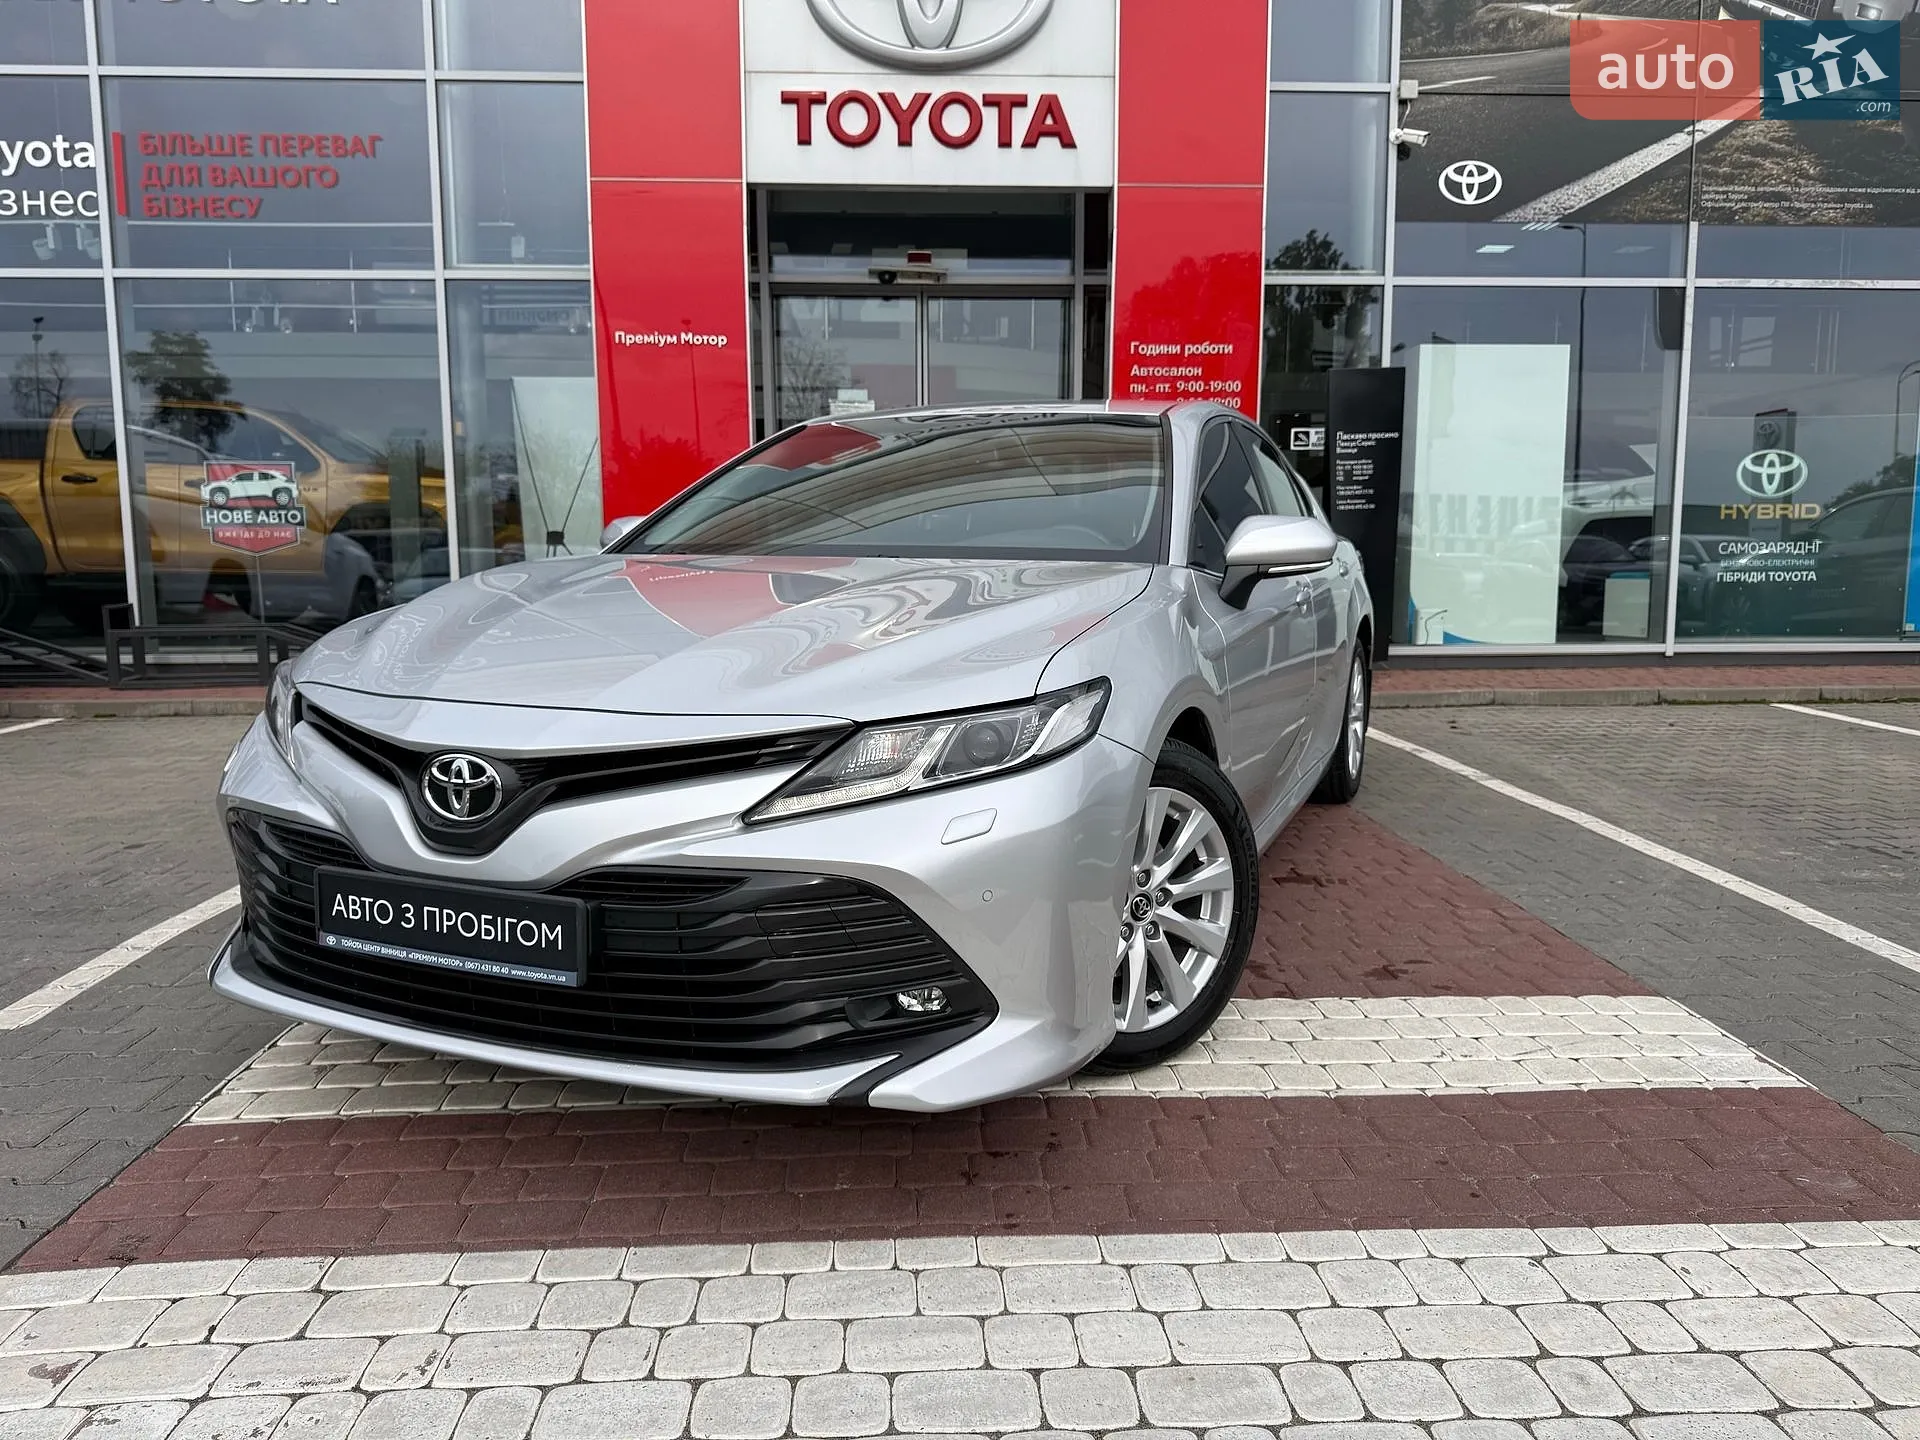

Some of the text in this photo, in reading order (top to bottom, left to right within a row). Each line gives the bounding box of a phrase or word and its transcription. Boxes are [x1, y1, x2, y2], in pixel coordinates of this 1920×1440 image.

[780, 91, 1077, 149] TOYOTA
[139, 131, 383, 157] БІЛЬШЕ ПЕРЕВАГ
[140, 164, 339, 189] ДЛЯ ВАШОГО
[143, 196, 262, 218] БІЗНЕСУ
[614, 331, 728, 348] Преміум Мотор
[1130, 341, 1233, 357] Години роботи
[1130, 364, 1202, 376] Автосалон
[1176, 381, 1241, 393] 9:00-19:00
[205, 509, 301, 524] НОВЕ АВТО
[1720, 503, 1821, 520] HYBRID
[1719, 540, 1821, 555] САМОЗАРЯДНІ
[1717, 571, 1817, 583] ГІБРИДИ TOYOTA
[331, 893, 563, 951] АВТО З ПРОБІГОМ
[341, 939, 362, 949] ТОЙОТА
[363, 943, 381, 953] ЦЕНТР
[381, 946, 407, 958] ВІННИЦЯ
[408, 952, 438, 964] «ПРЕМІУМ
[464, 960, 481, 970] (067)
[481, 963, 492, 972] 431
[492, 964, 501, 973] 80
[501, 966, 509, 974] 40
[511, 968, 566, 982] www.toyota.vn.ua
